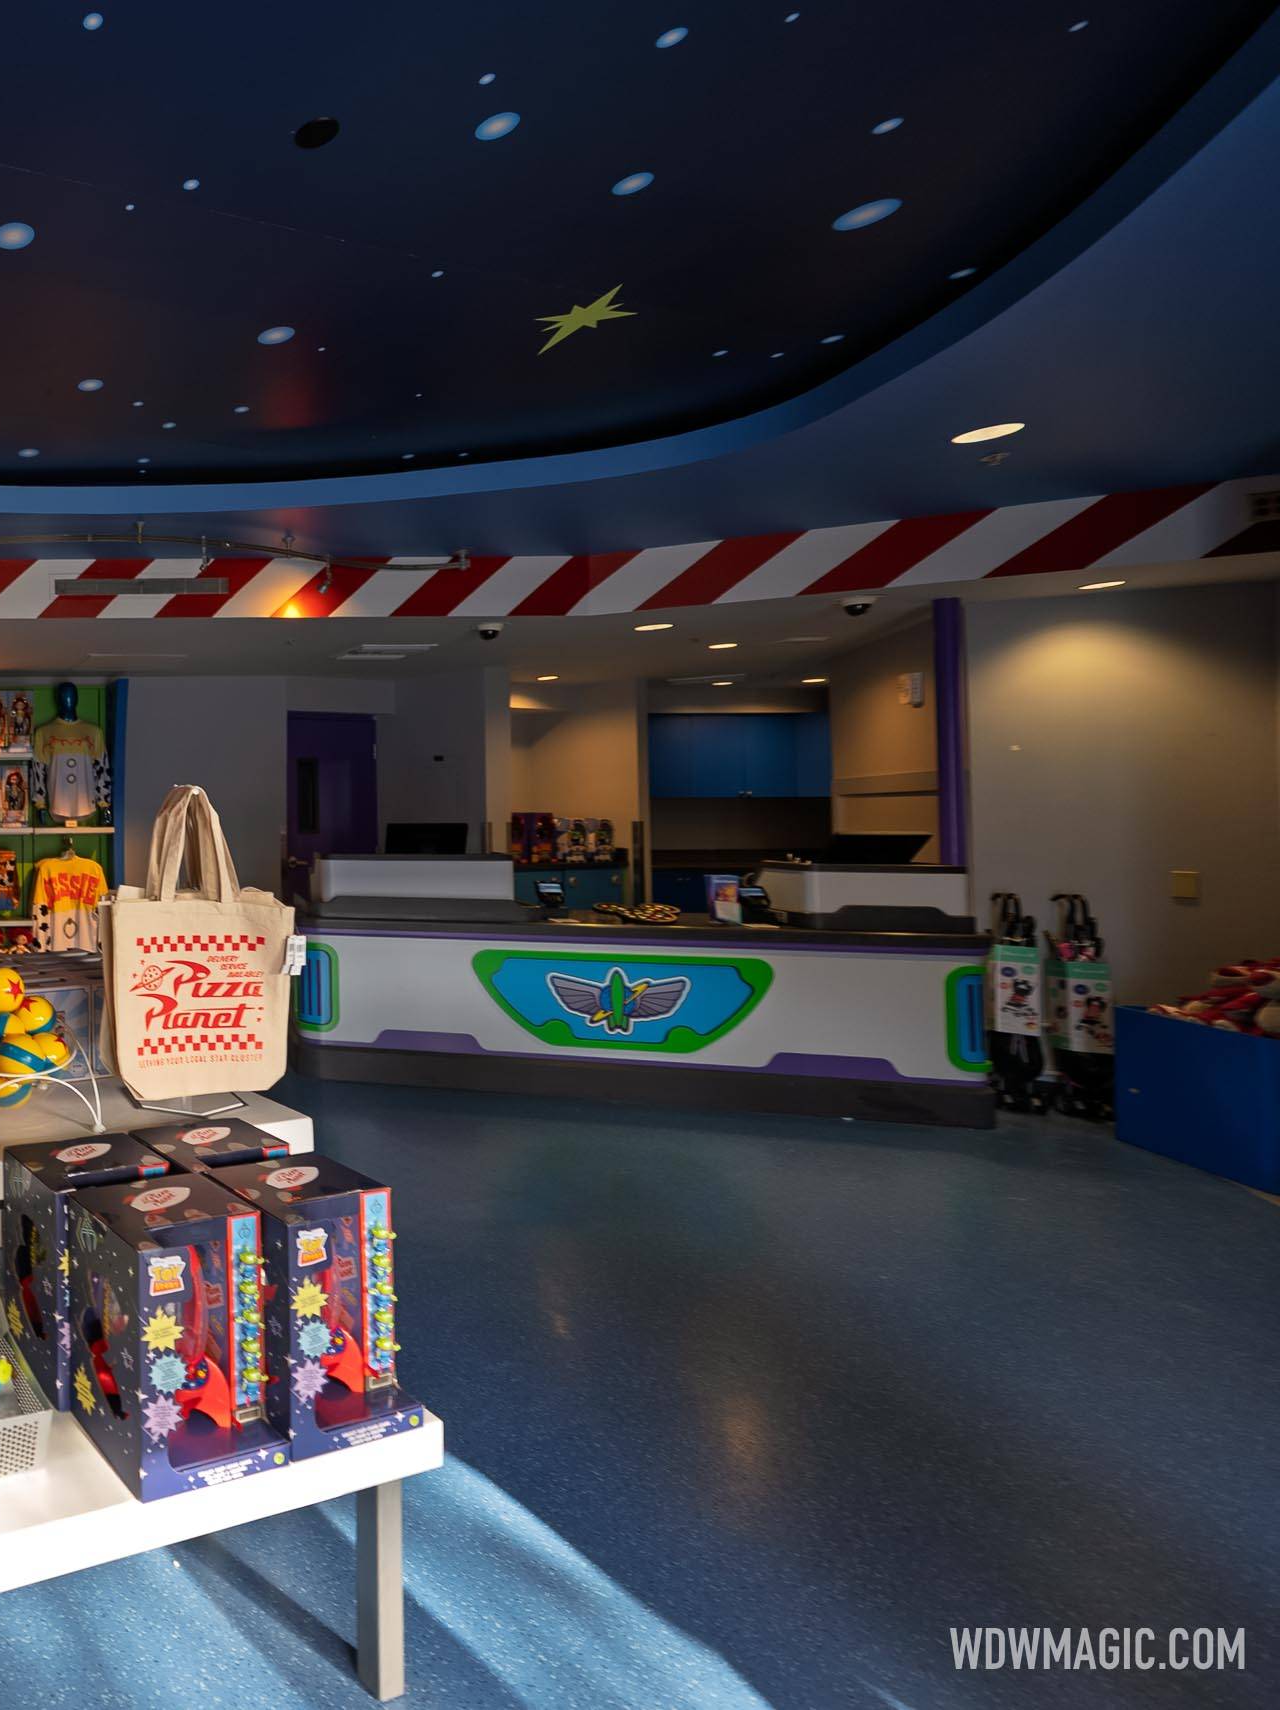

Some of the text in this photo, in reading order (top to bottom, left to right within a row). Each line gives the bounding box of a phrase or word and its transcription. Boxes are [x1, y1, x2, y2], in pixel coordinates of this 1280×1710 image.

[165, 960, 264, 998] Pizza
[135, 993, 257, 1032] Planet
[151, 1264, 181, 1282] TOY
